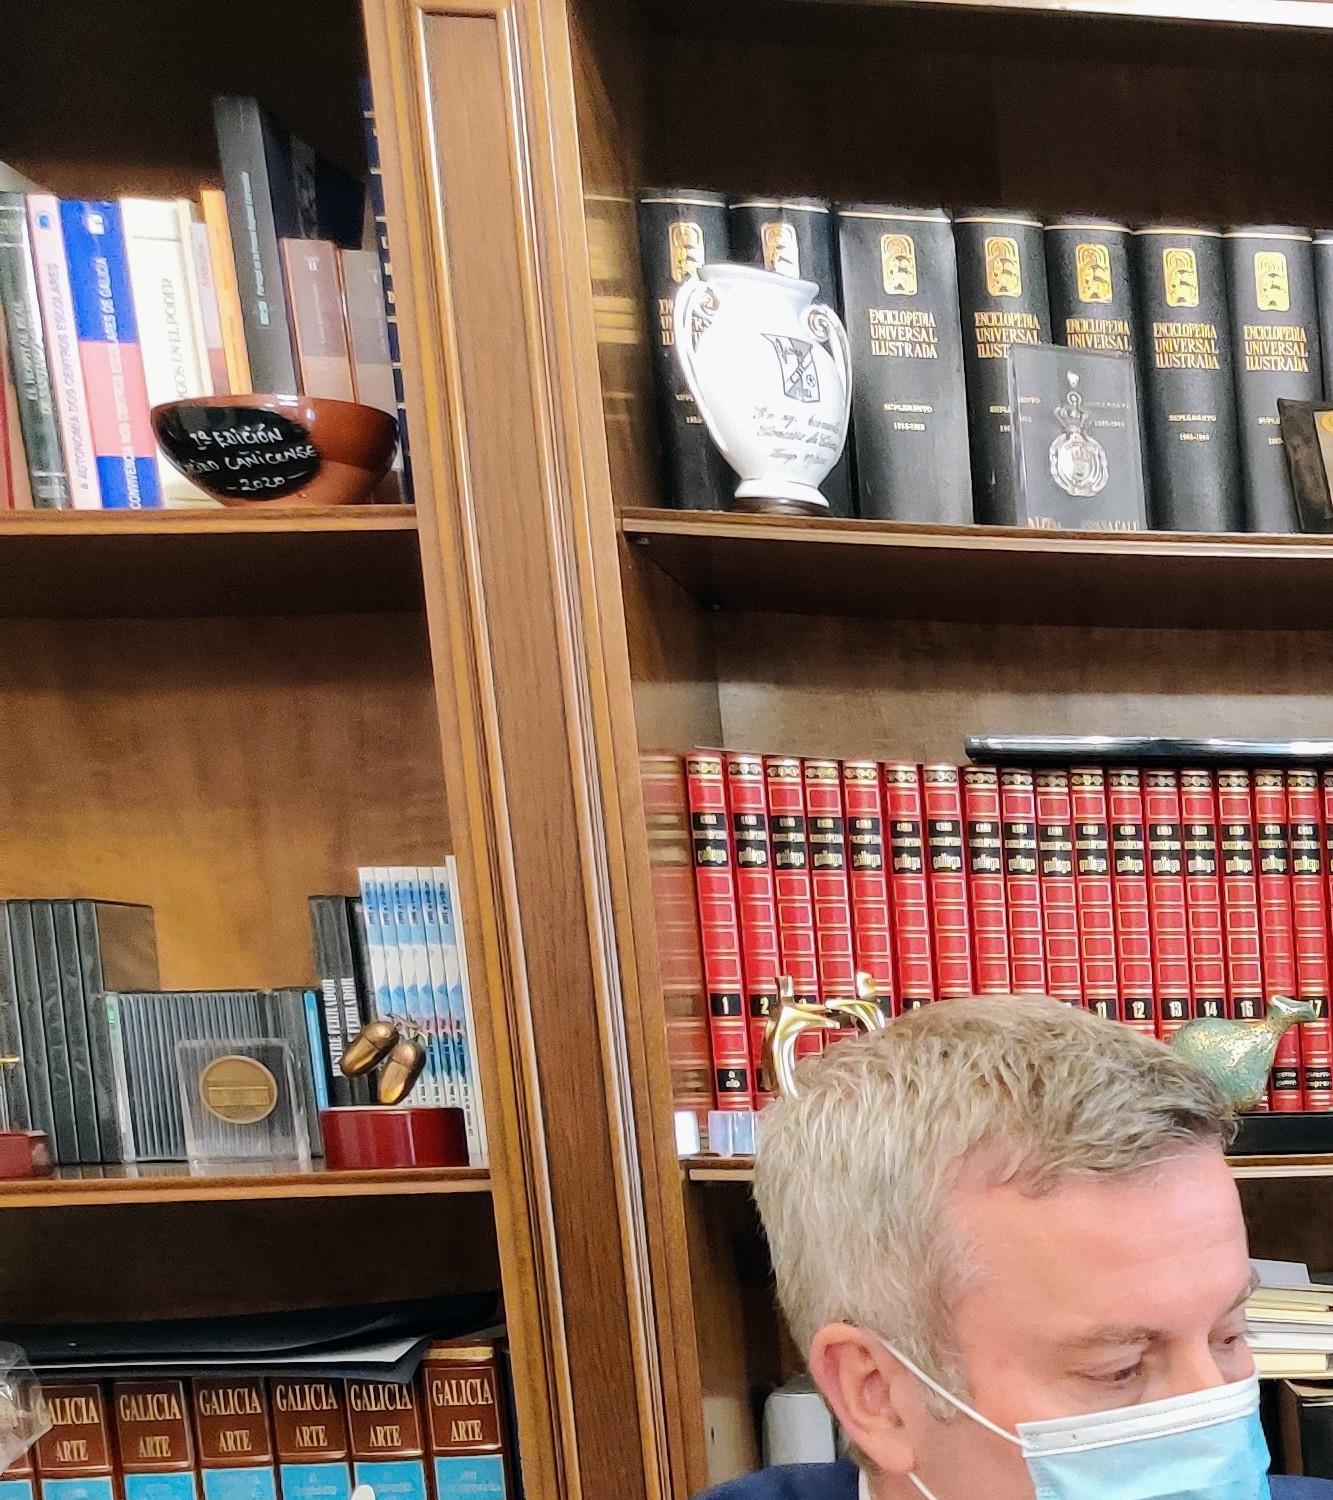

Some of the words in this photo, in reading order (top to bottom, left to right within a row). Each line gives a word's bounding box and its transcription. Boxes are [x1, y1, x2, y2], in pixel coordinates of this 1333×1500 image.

[95, 257, 113, 298] GALICIA
[47, 262, 70, 332] ESCOLARES
[161, 277, 179, 326] PODER
[869, 308, 937, 328] ENCICLOPEDIA
[974, 312, 1040, 329] ENCICLOPEDIA
[870, 326, 938, 343] UNIVERSAL
[976, 327, 1041, 345] UNIVERSAL
[1153, 321, 1218, 339] ENCICLOPEDIA
[1243, 323, 1307, 343] ENCICLOPEDIA
[871, 341, 939, 359] ILUSTRADA
[1153, 337, 1219, 355] UNIVERSAL
[1244, 341, 1309, 358] UNIVERSAL
[1155, 353, 1221, 370] ILUSTRADA
[1245, 355, 1310, 373] ILUSTRADA
[214, 423, 284, 449] EDICIÓN
[238, 476, 287, 492] 2020
[322, 978, 341, 1036] FERRADOR
[340, 977, 361, 1035] FERRADOR
[721, 995, 730, 1015] 1
[760, 996, 770, 1016] 2
[1095, 1000, 1108, 1019] 11
[1131, 1000, 1147, 1019] 12
[1203, 1000, 1218, 1018] 14
[200, 1387, 263, 1416] GALICIA
[276, 1383, 339, 1412] GALICIA
[351, 1383, 413, 1412] GALICIA
[432, 1377, 495, 1407] GALICIA
[119, 1392, 183, 1422] GALICIA
[218, 1429, 252, 1453] ARTE
[294, 1425, 328, 1449] ARTE
[369, 1425, 402, 1448] ARTE
[450, 1419, 483, 1442] ARTE
[56, 1439, 90, 1463] ARTE
[138, 1435, 172, 1459] ARTE
